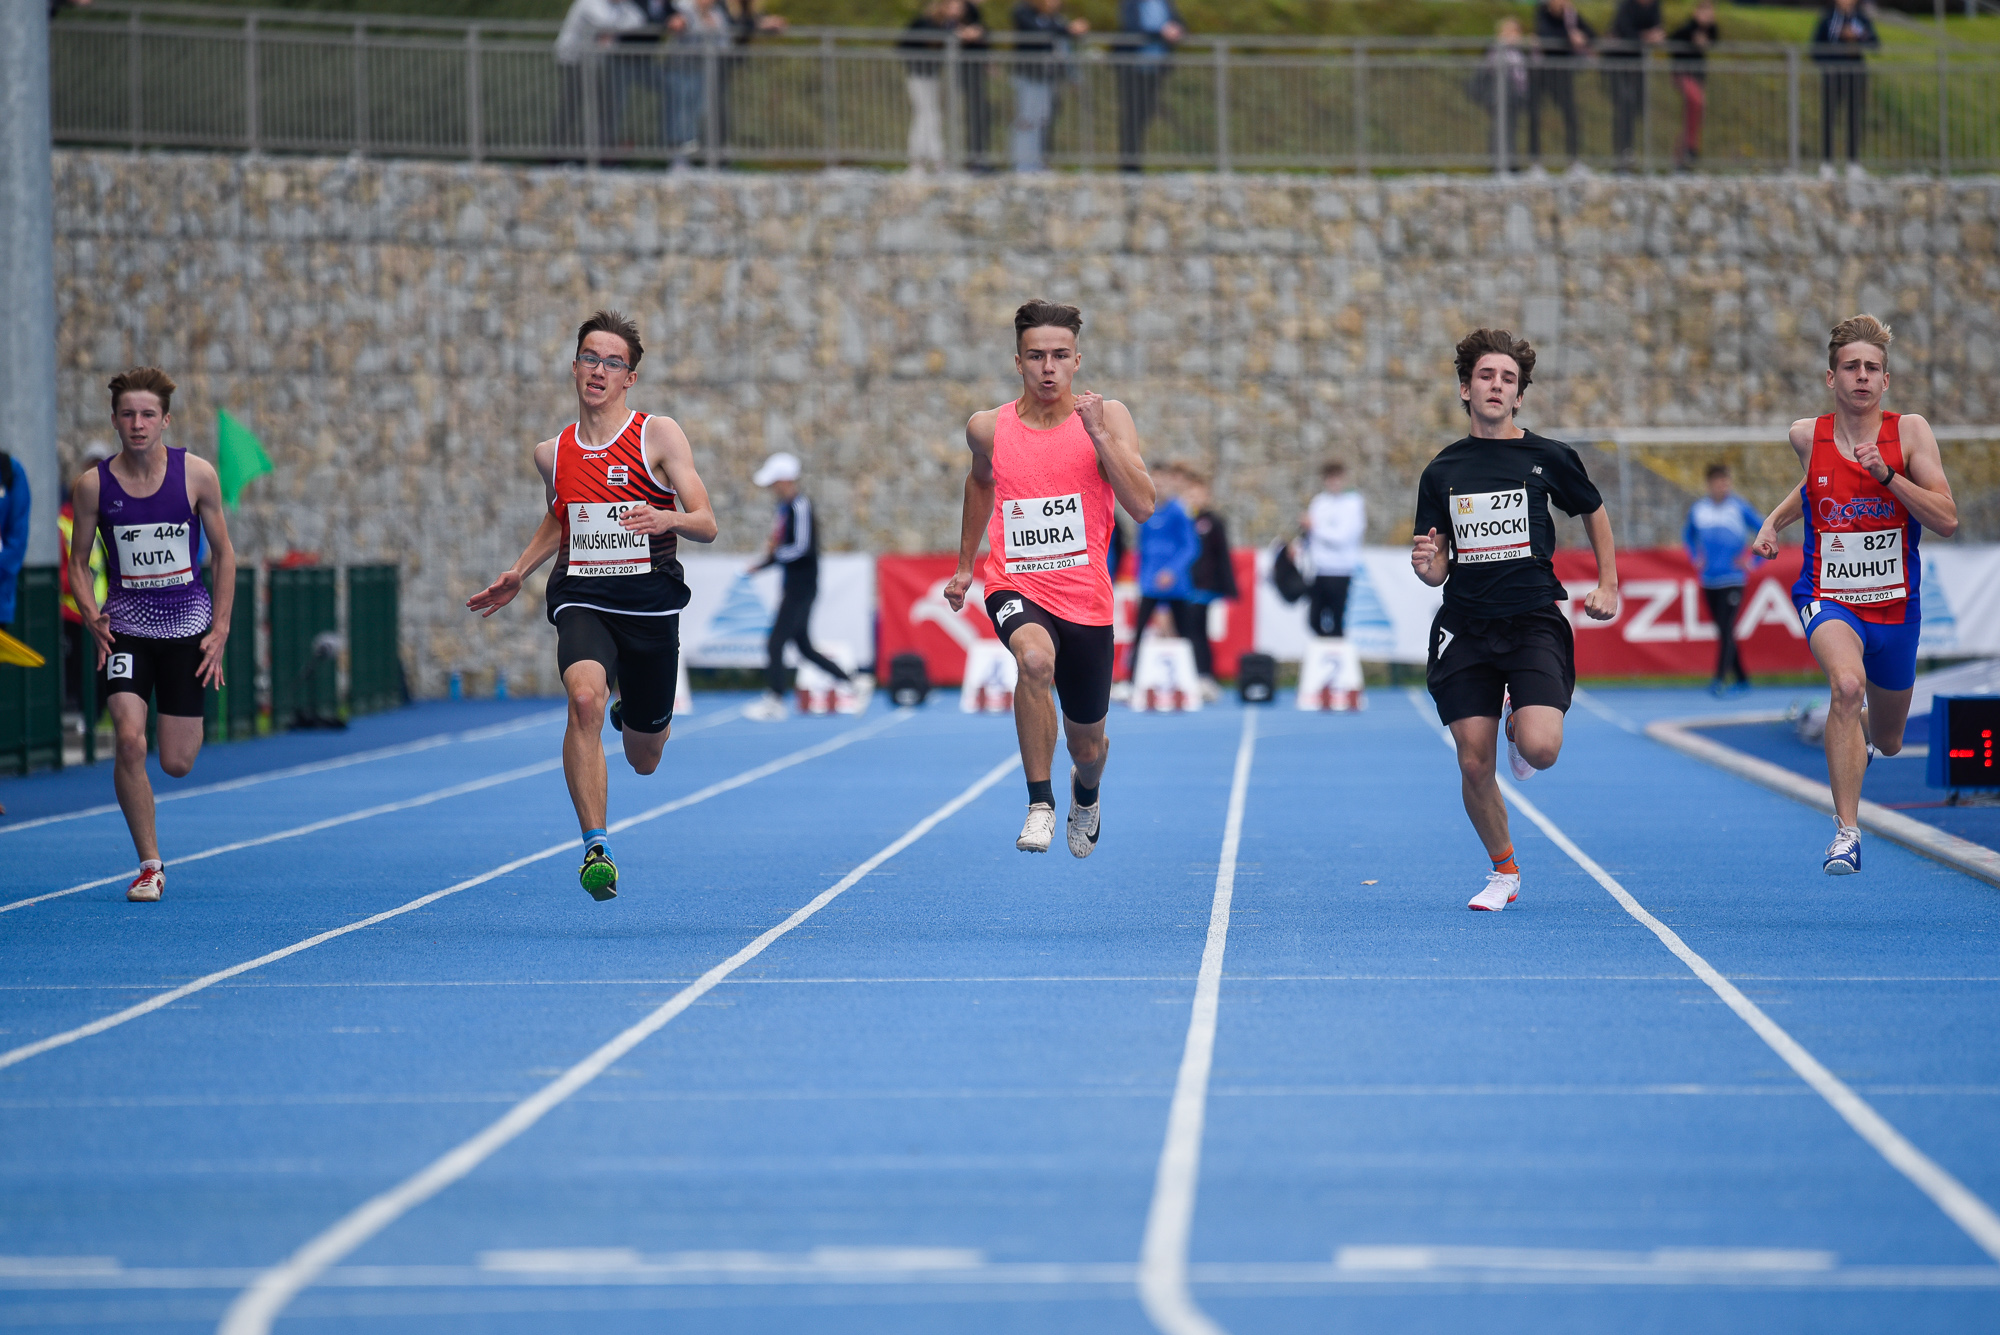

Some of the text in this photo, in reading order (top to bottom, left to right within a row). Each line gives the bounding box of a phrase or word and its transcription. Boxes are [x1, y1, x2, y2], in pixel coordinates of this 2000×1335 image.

[582, 452, 608, 460] COLO
[1042, 497, 1077, 517] 654
[1490, 492, 1523, 511] 279
[1841, 501, 1896, 520] ORKAN
[607, 503, 639, 522] 48
[120, 529, 141, 542] 4F
[153, 525, 185, 541] 446
[1012, 525, 1075, 548] LIBURA
[1455, 517, 1527, 539] WYSOCKI
[572, 530, 646, 550] MIKUŚKIEWICZ
[1863, 532, 1897, 551] 827
[131, 549, 176, 567] KUTA
[1015, 558, 1076, 572] KARPACZ 2021
[1464, 549, 1522, 562] KARPACZ 2021
[578, 565, 638, 575] KARPACZ 2021
[1826, 558, 1897, 579] RAUHUT
[166, 575, 184, 585] 2021
[1874, 591, 1894, 601] 2021
[1002, 601, 1017, 618] 3
[1560, 576, 1807, 643] PZLA
[111, 655, 127, 675] 5
